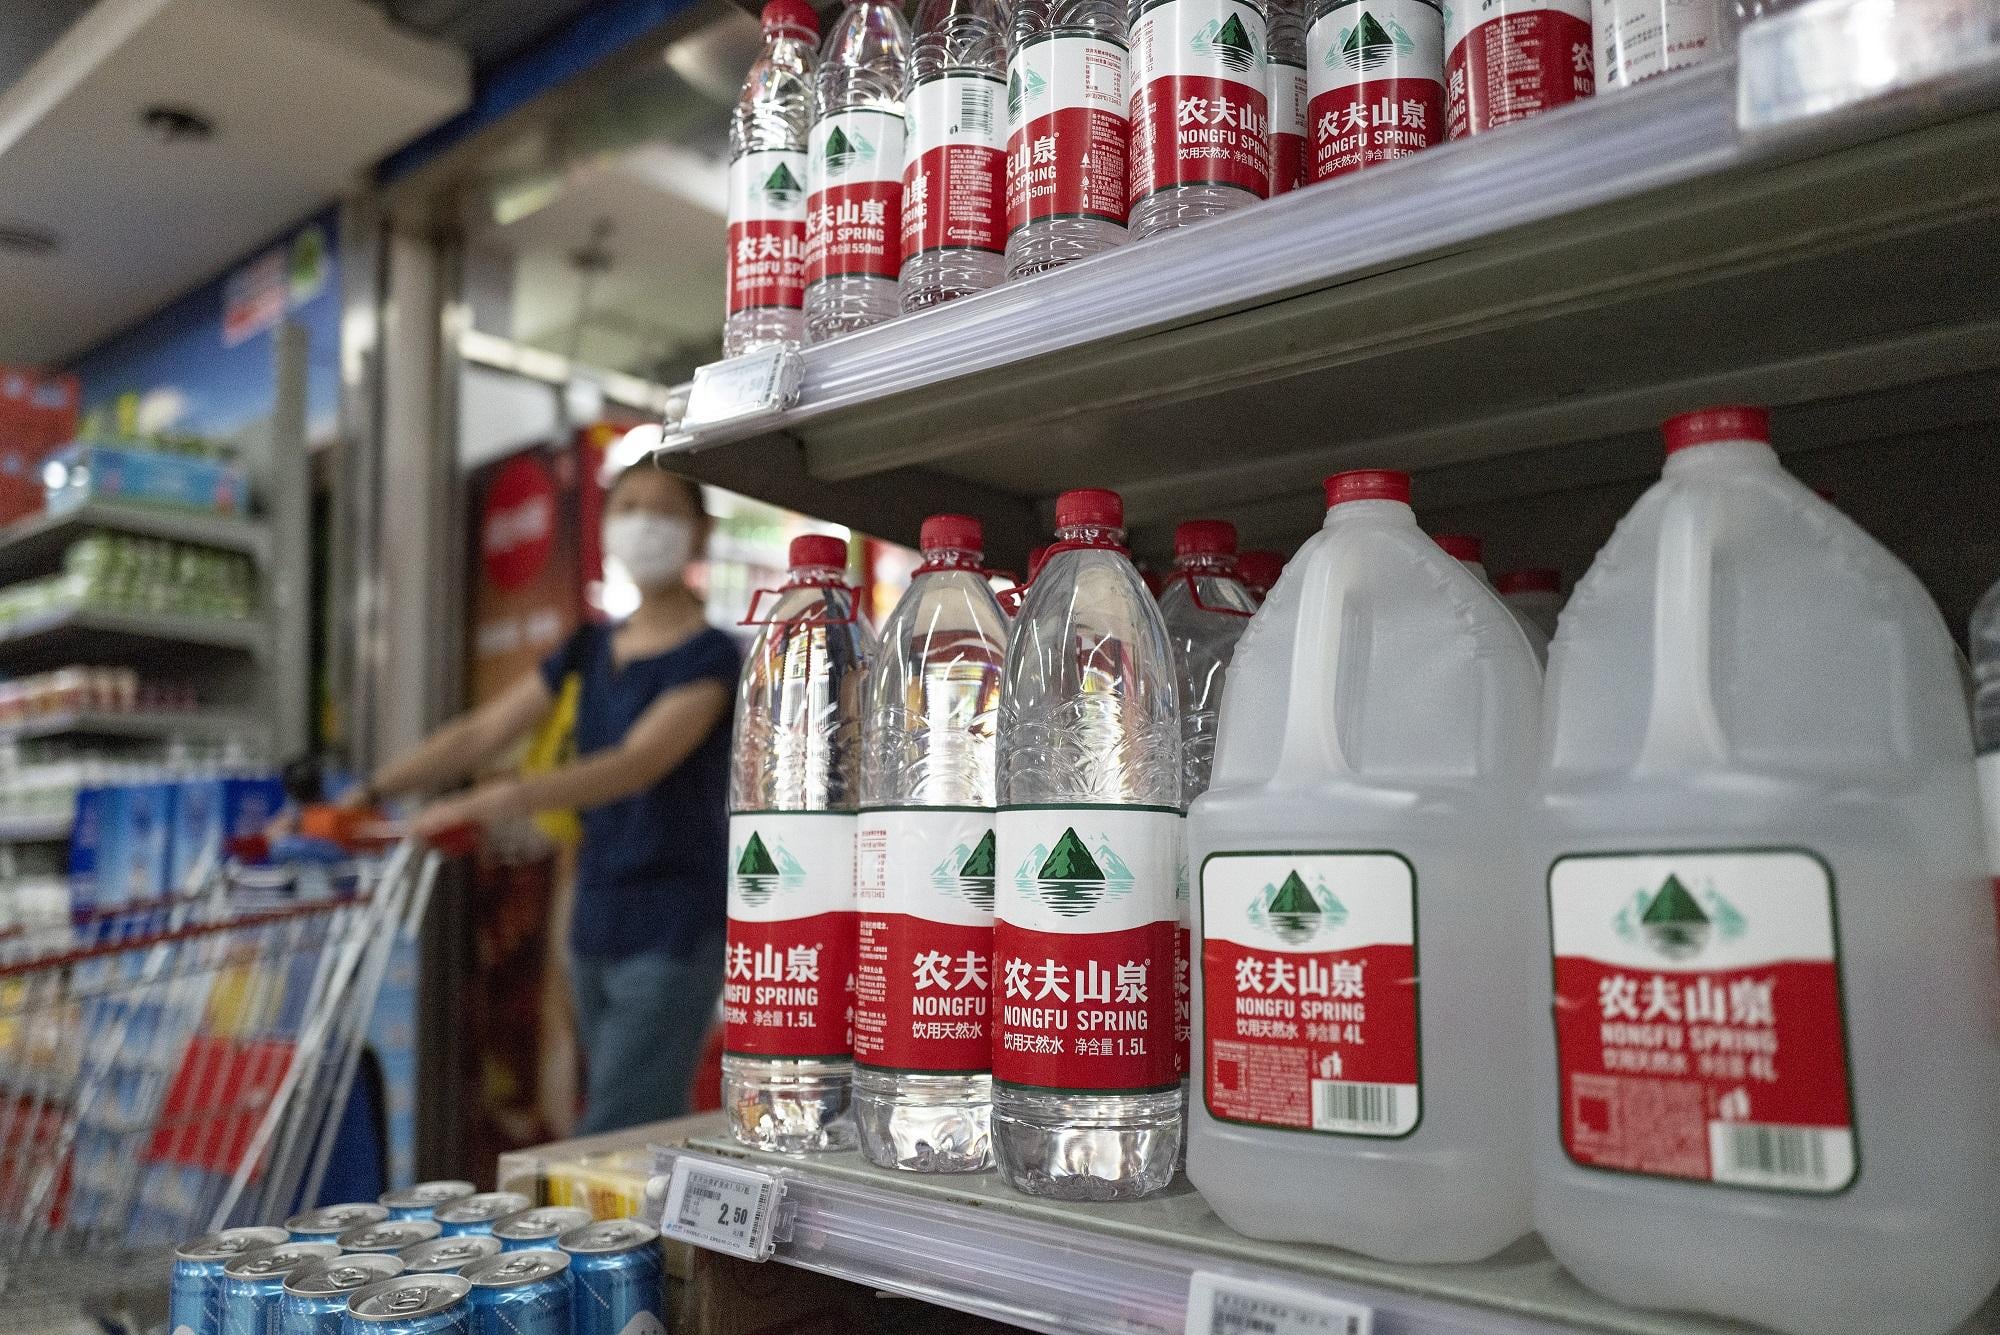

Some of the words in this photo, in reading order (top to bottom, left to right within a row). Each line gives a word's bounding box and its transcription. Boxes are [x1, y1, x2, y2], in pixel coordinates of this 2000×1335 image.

[1447, 68, 1466, 112] 泉
[1573, 75, 1594, 94] NO
[1316, 97, 1427, 145] 农夫山泉
[1178, 129, 1236, 145] NONGFU
[1241, 134, 1268, 166] SPRIN
[1179, 147, 1231, 160] 饮用天然水
[1318, 133, 1368, 163] NONGFU
[1374, 130, 1427, 148] SPRING
[1015, 165, 1057, 191] SPRING
[1318, 152, 1362, 178] 饮用天然水
[837, 227, 885, 242] SPRING
[912, 950, 988, 991] 农夫
[1004, 957, 1149, 1004] 农夫山泉
[1234, 957, 1366, 1000] 农夫山泉
[755, 986, 818, 1006] SPRING
[912, 996, 986, 1017] NONGFU
[786, 1011, 816, 1028] 1.5L
[1004, 1005, 1068, 1030] NONGFU
[1077, 1010, 1148, 1031] SPRING
[1236, 997, 1295, 1018] NONGFU
[1301, 1001, 1365, 1023] SPRING
[912, 1021, 983, 1040] 饮用天然水
[1343, 1024, 1365, 1045] 4L
[1004, 1032, 1064, 1054] 饮用天然水
[1074, 1037, 1113, 1056] 净含量
[1117, 1038, 1147, 1056] 1.5L
[718, 1203, 748, 1226] 2.50
